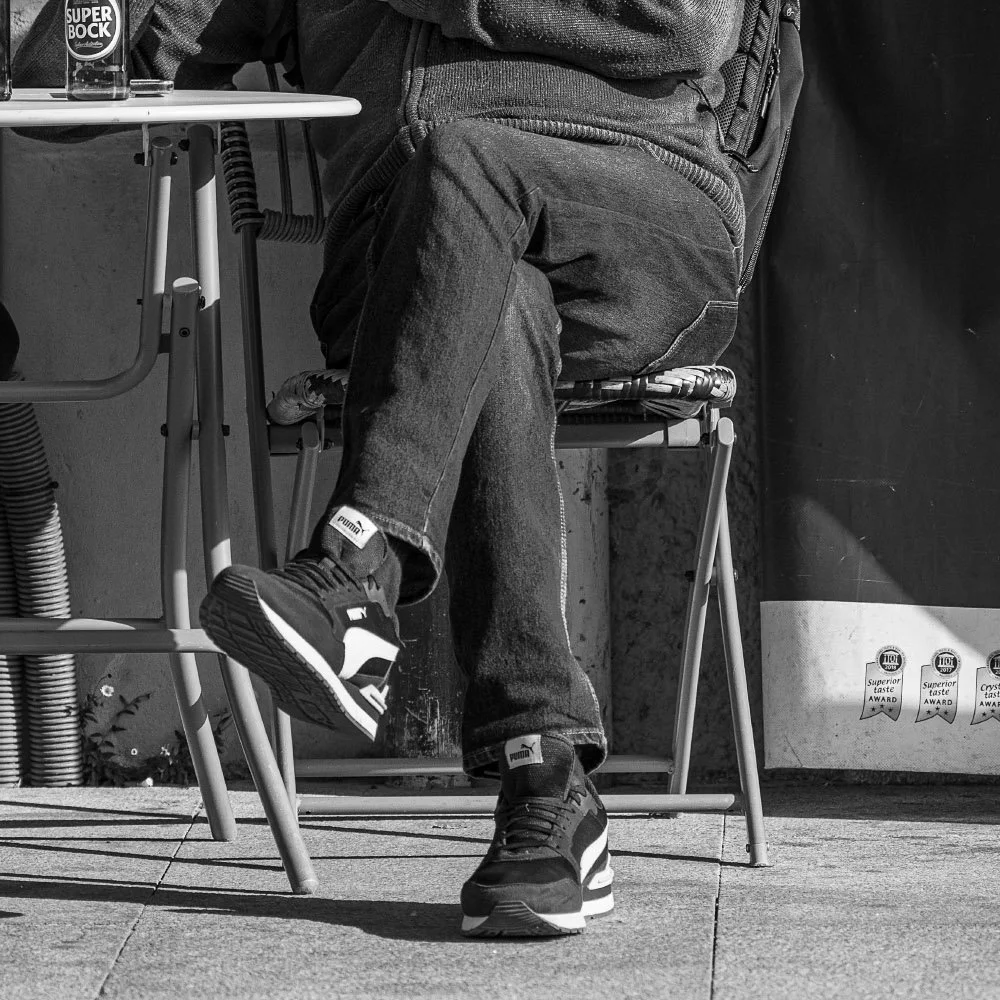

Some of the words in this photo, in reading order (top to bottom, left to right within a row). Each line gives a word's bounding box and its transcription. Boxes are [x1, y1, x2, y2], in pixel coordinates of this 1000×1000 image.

[66, 5, 113, 24] SUPER
[68, 21, 112, 40] BOCK
[337, 515, 361, 535] PUMA
[867, 678, 901, 688] Superior
[922, 680, 956, 690] Superior
[873, 686, 895, 694] taste
[929, 688, 950, 697] taste
[868, 695, 898, 703] AWARD
[923, 698, 953, 706] AWARD
